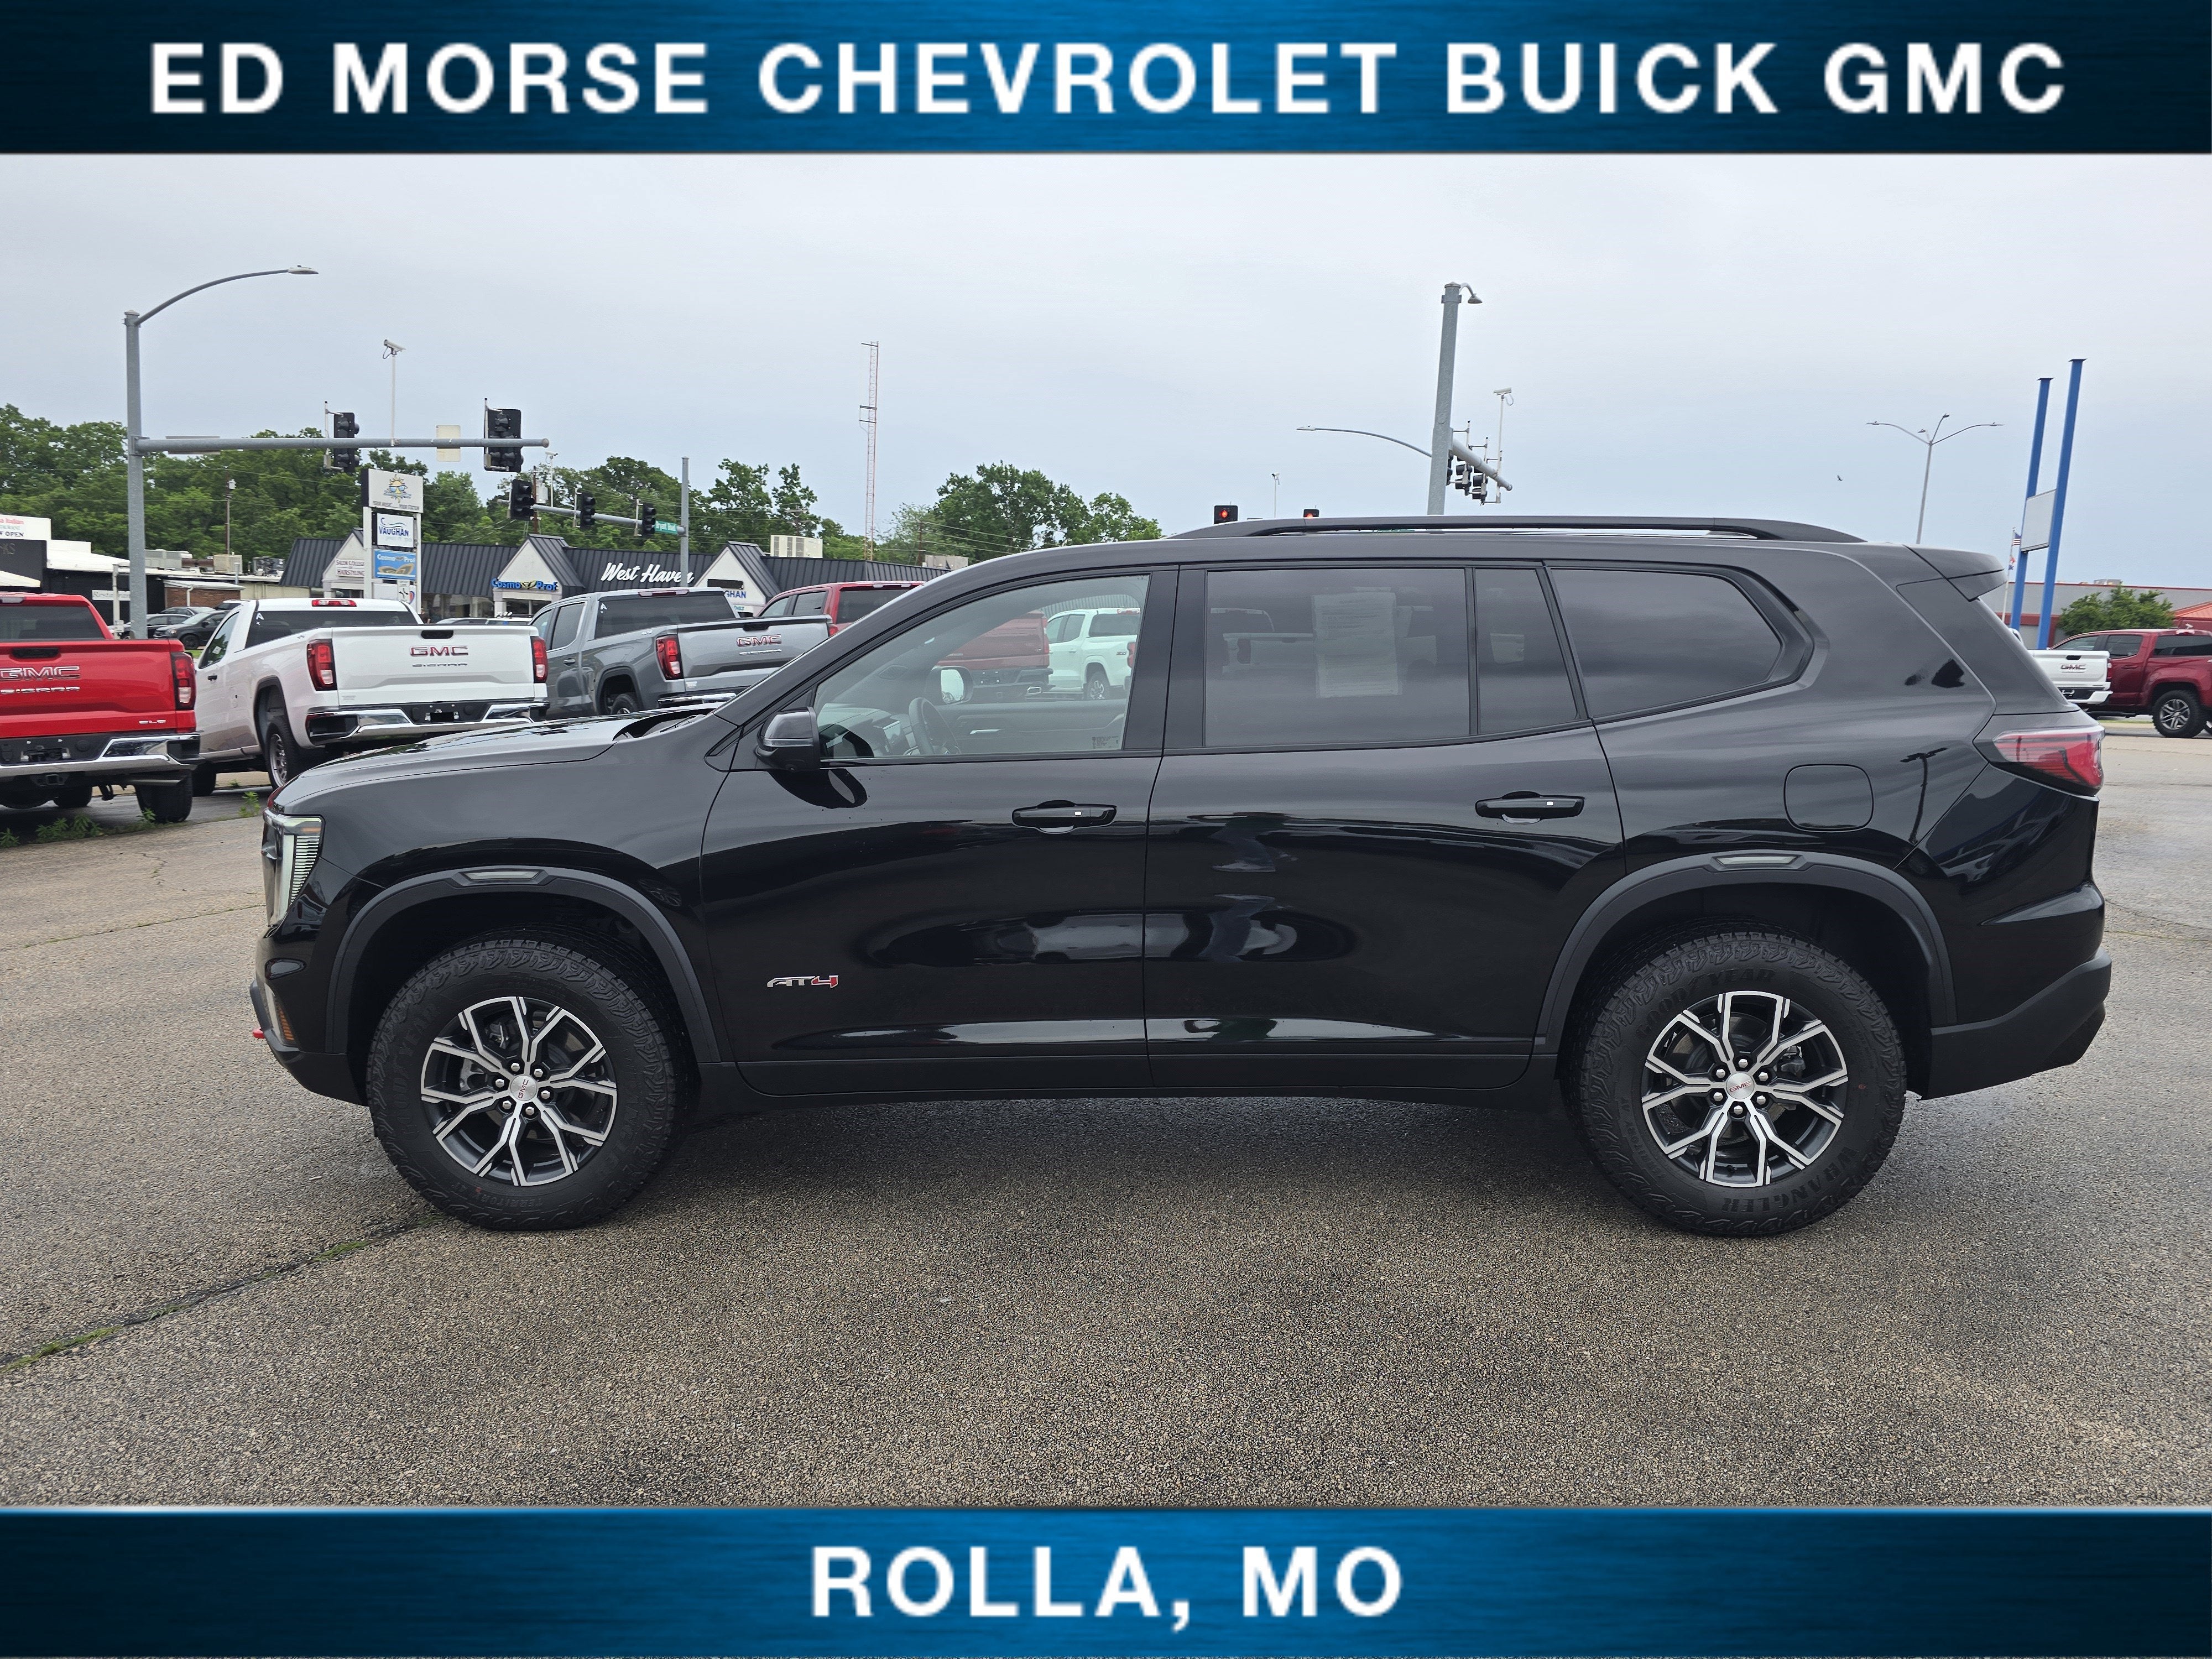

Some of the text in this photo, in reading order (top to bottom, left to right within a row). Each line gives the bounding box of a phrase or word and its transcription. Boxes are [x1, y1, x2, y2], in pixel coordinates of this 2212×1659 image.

[379, 526, 409, 537] VAUGHAN
[377, 554, 395, 562] Cosmo
[601, 562, 641, 581] West
[491, 578, 558, 591] Cosmo Prof
[724, 590, 747, 598] GHAN
[737, 634, 782, 648] GMC
[410, 645, 468, 657] GMC
[0, 665, 80, 681] GMC
[767, 975, 839, 988] AT4
[518, 1078, 529, 1099] GMC
[1729, 1079, 1752, 1093] GMC
